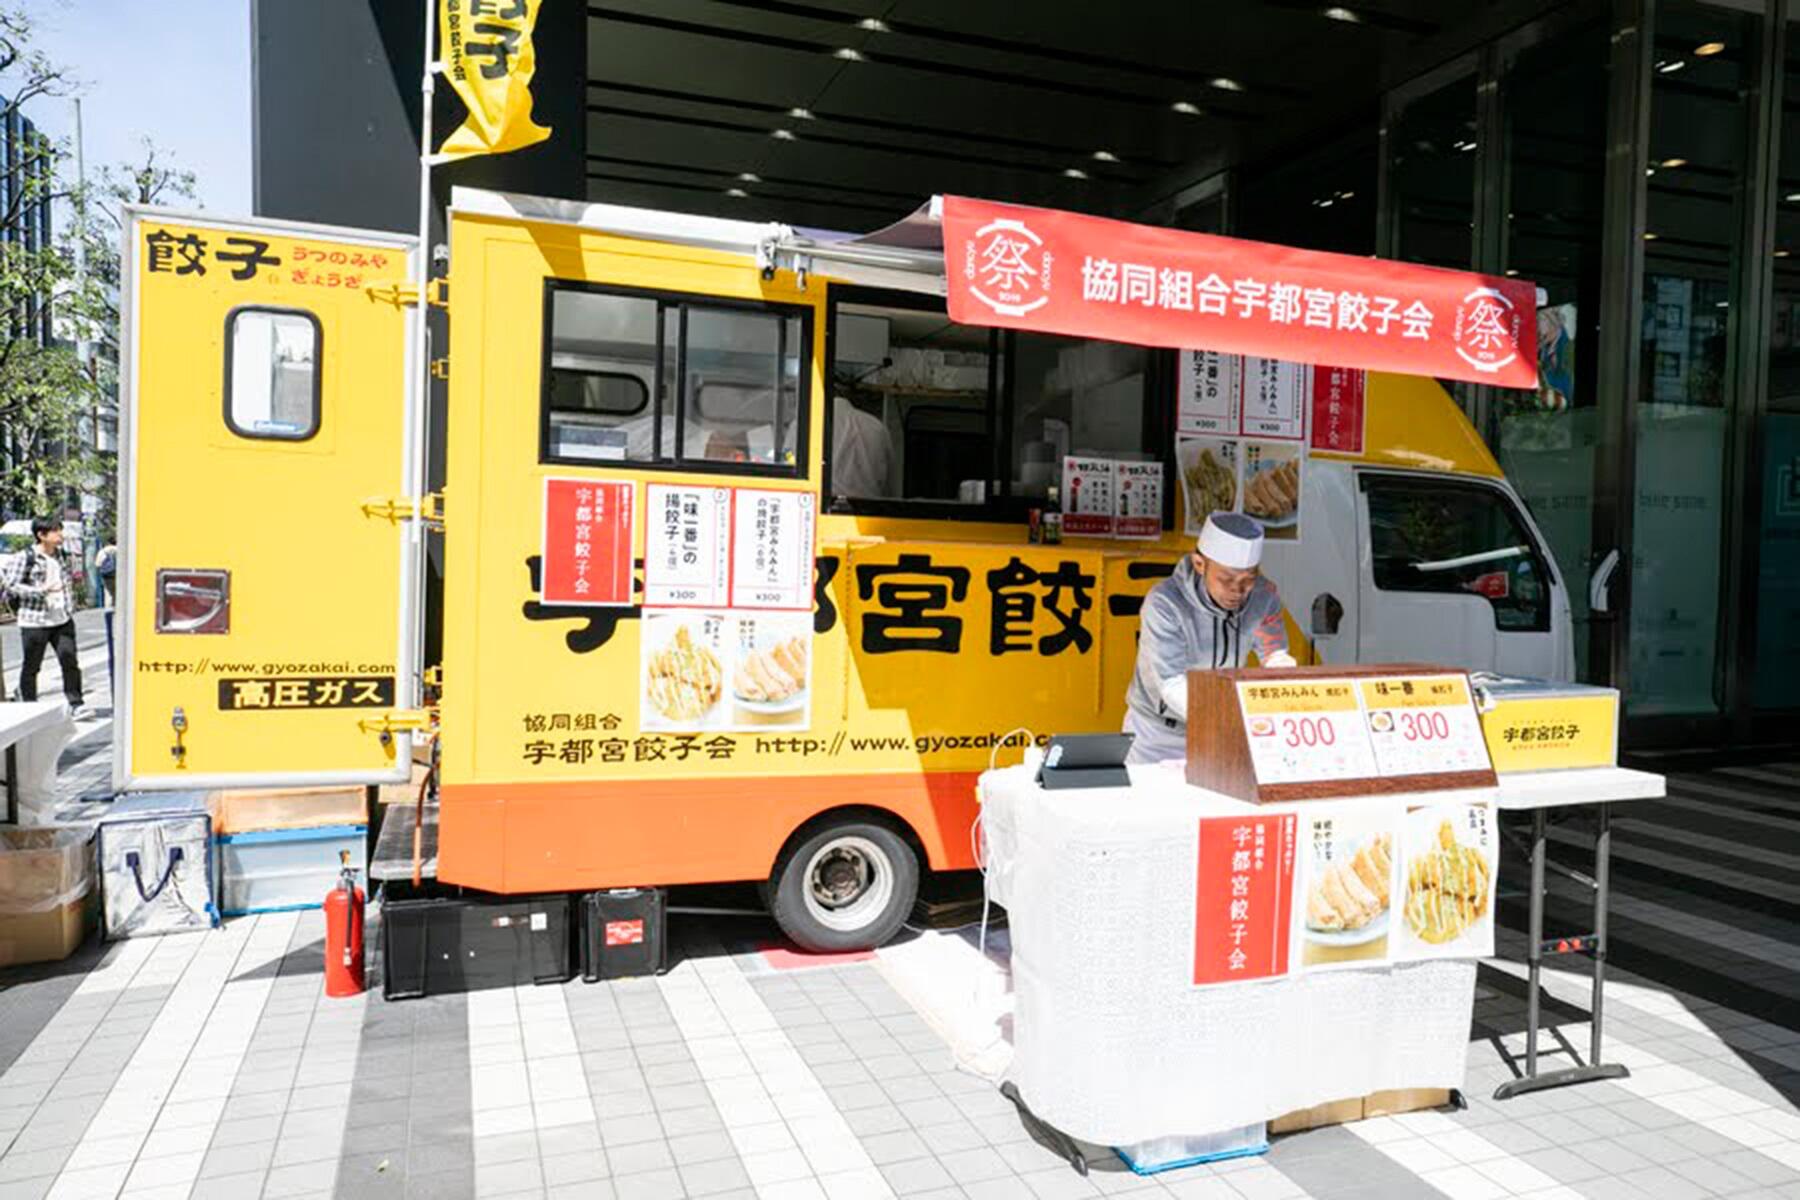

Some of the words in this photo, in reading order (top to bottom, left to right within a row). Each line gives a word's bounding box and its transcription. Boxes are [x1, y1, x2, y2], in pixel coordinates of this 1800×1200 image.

[146, 229, 281, 280] 餃子
[292, 246, 388, 268] うつのみや
[980, 234, 1037, 290] 祭
[292, 269, 363, 288] ぎょうざ
[1082, 256, 1434, 340] 協同組合宇都宮餃子会
[1465, 299, 1509, 349] 祭
[1329, 367, 1341, 446] 都宮餃子会
[575, 487, 592, 594] 宇都宮餃子会
[139, 658, 396, 675] http://www.gyozakai.com
[232, 680, 384, 708] 高圧ガス
[523, 714, 622, 733] 協同組合
[1283, 716, 1336, 748] 300
[1401, 711, 1449, 741] 300
[1503, 724, 1581, 743] 宇都宮餃子
[523, 736, 737, 765] 宇都宮餃子会
[1229, 826, 1252, 970] 宇都宮餃子会
